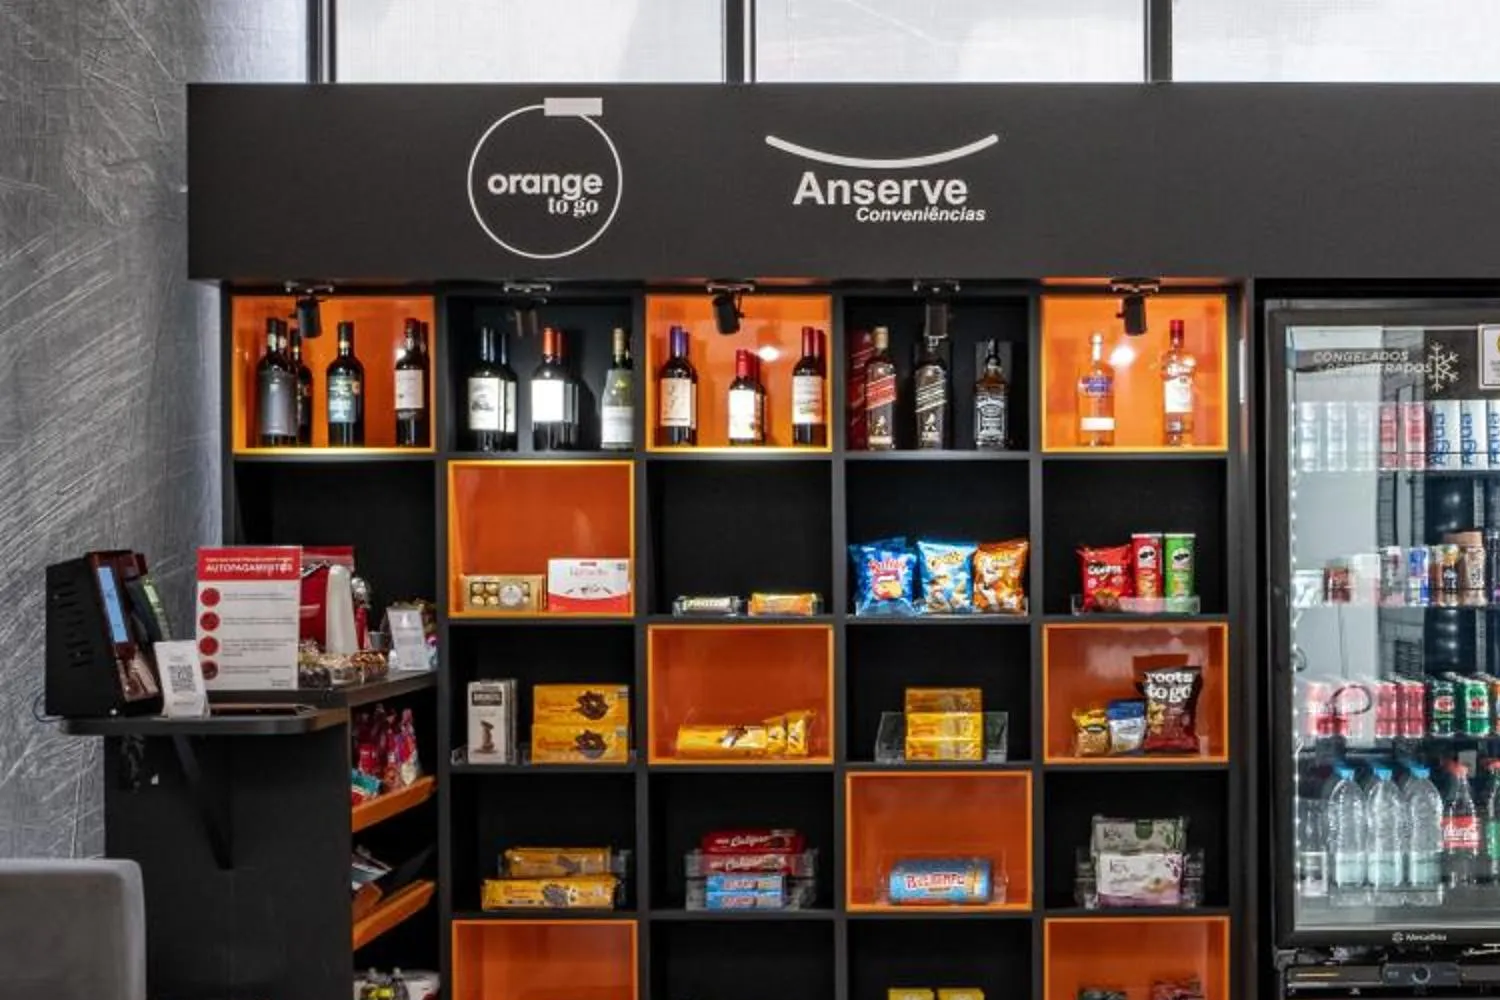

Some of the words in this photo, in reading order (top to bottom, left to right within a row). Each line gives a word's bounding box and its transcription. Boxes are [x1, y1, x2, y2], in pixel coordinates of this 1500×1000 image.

[487, 173, 603, 200] orange
[792, 171, 969, 206] Anserve
[547, 197, 569, 215] to
[573, 197, 600, 218] go
[855, 206, 986, 223] Conveniências
[1146, 671, 1194, 684] roots
[1147, 683, 1168, 700] to
[1169, 684, 1193, 704] go
